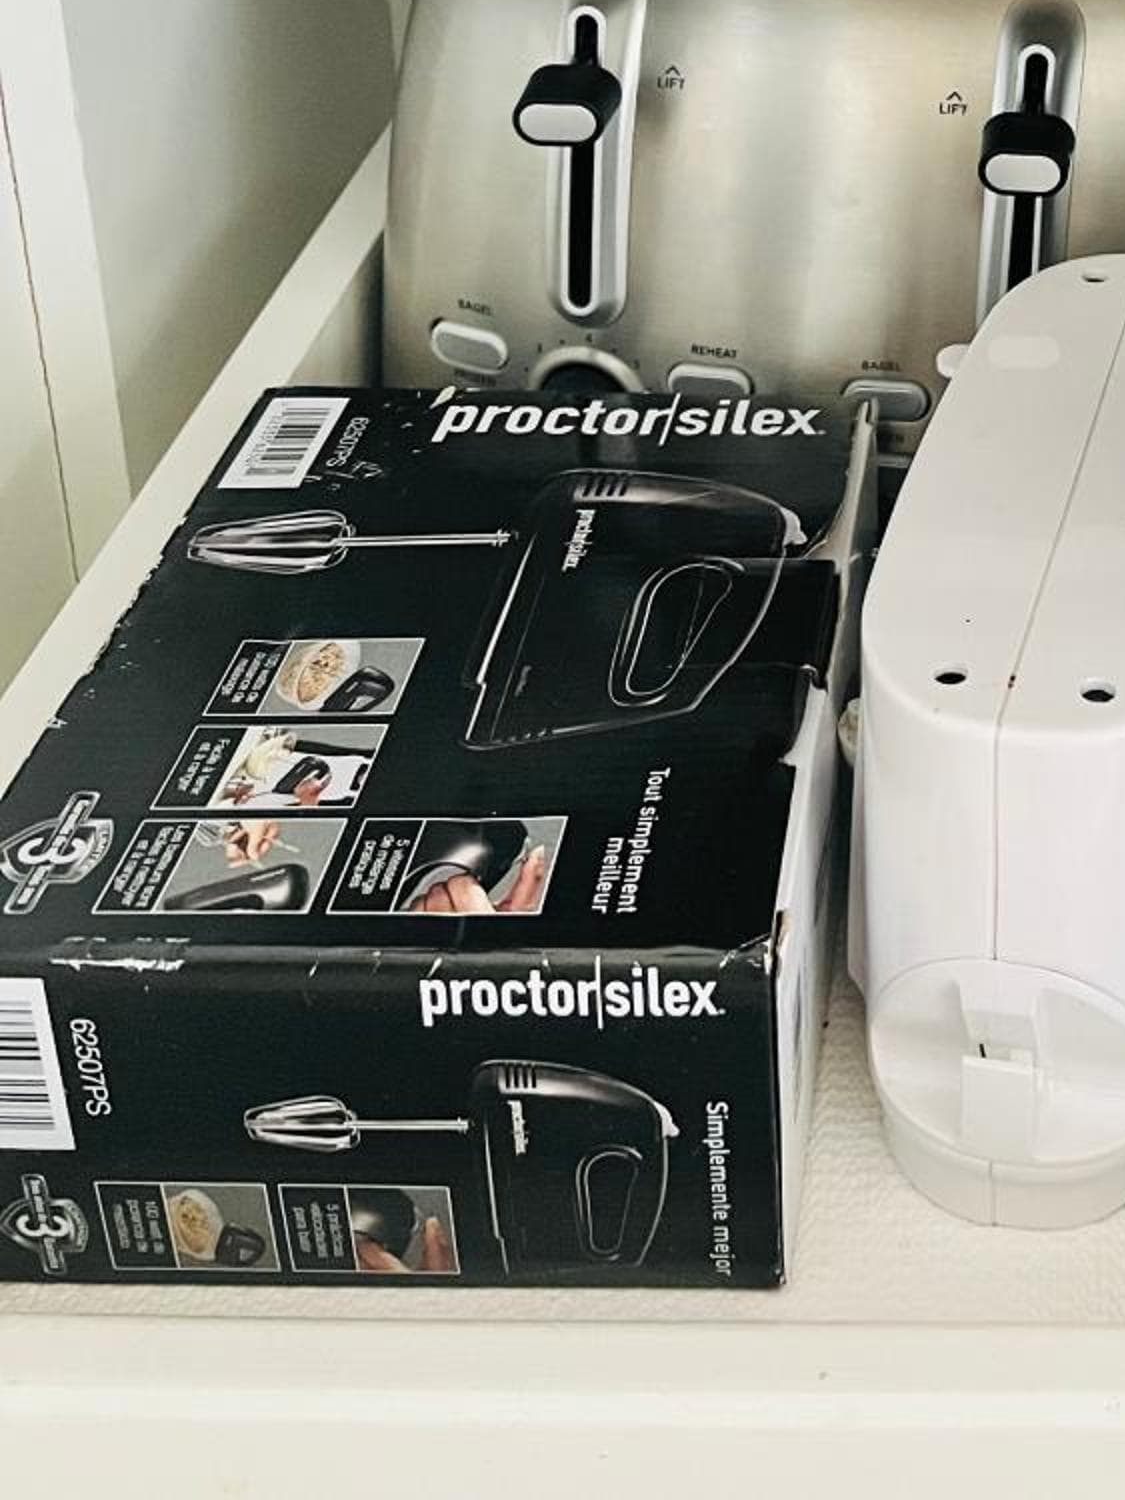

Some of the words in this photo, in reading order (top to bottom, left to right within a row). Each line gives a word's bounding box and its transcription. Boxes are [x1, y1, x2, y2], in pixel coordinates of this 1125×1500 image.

[656, 76, 686, 90] LIFT
[938, 102, 969, 116] LIFT
[691, 343, 738, 359] REHEAT
[642, 766, 671, 805] Tout
[591, 837, 624, 914] meilleur
[616, 805, 657, 915] simplement
[69, 1018, 112, 1117] 62507PS
[705, 1101, 730, 1221] Simplemente
[709, 1227, 737, 1277] mejor
